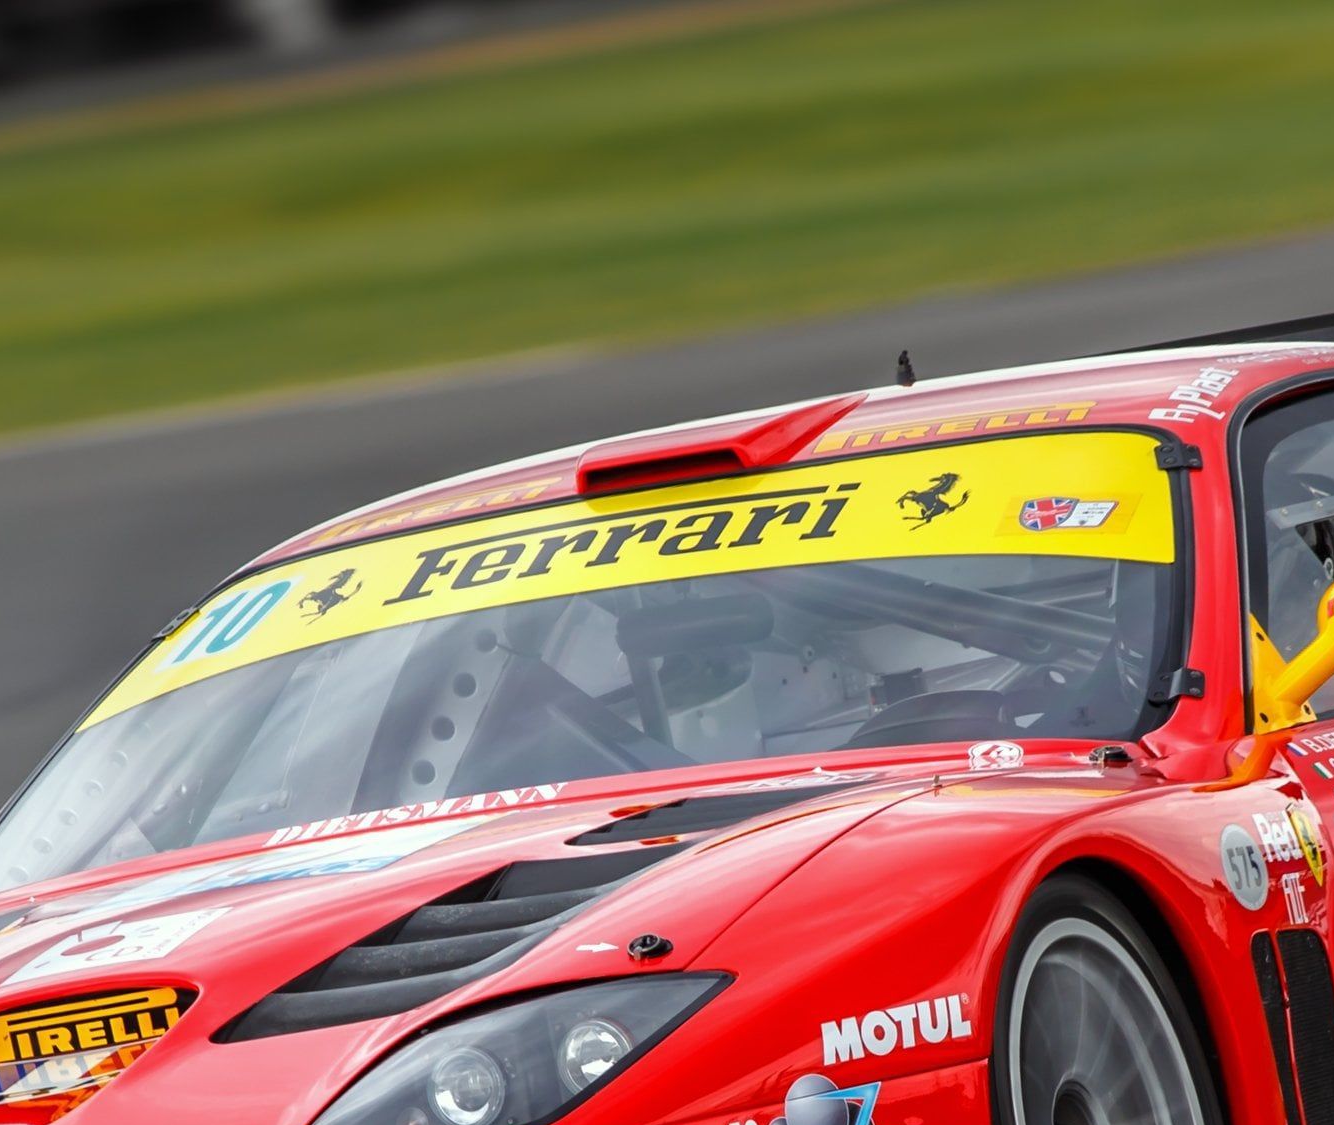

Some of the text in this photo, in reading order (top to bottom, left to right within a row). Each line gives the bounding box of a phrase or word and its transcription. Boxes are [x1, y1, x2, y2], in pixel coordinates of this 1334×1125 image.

[812, 400, 1099, 454] PIRELLI
[381, 482, 862, 606] Ferrari
[173, 580, 293, 665] 10
[262, 782, 568, 848] DIETSMANN
[1226, 845, 1263, 891] 575
[821, 994, 972, 1066] MOTUL
